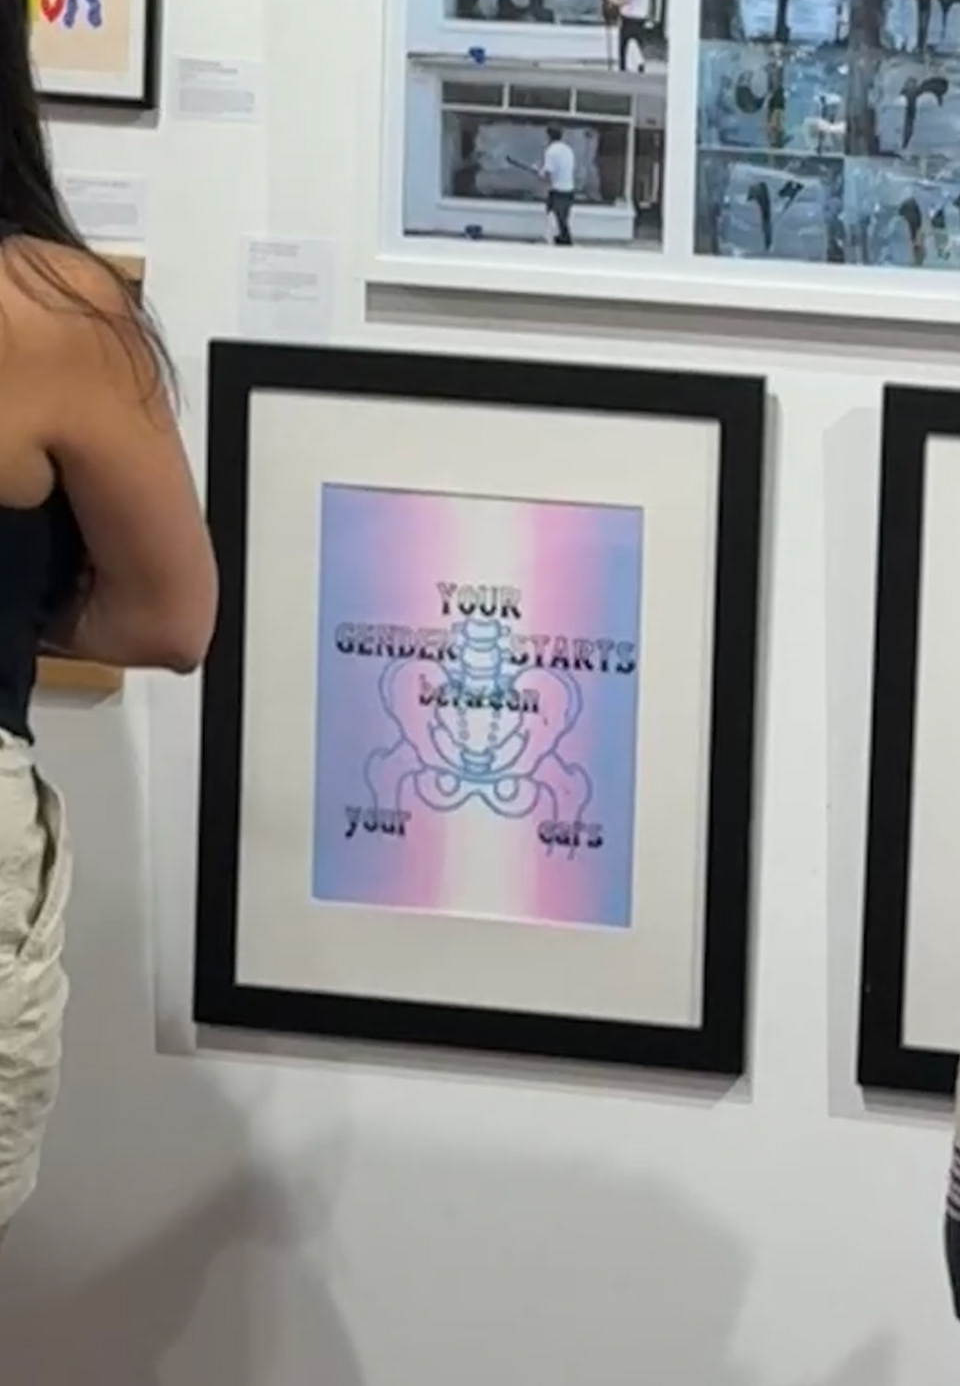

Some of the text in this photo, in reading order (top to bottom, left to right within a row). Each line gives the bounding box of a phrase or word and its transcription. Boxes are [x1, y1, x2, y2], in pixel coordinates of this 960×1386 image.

[437, 582, 521, 619] YOUR
[508, 634, 636, 674] STARTS
[344, 806, 412, 839] your
